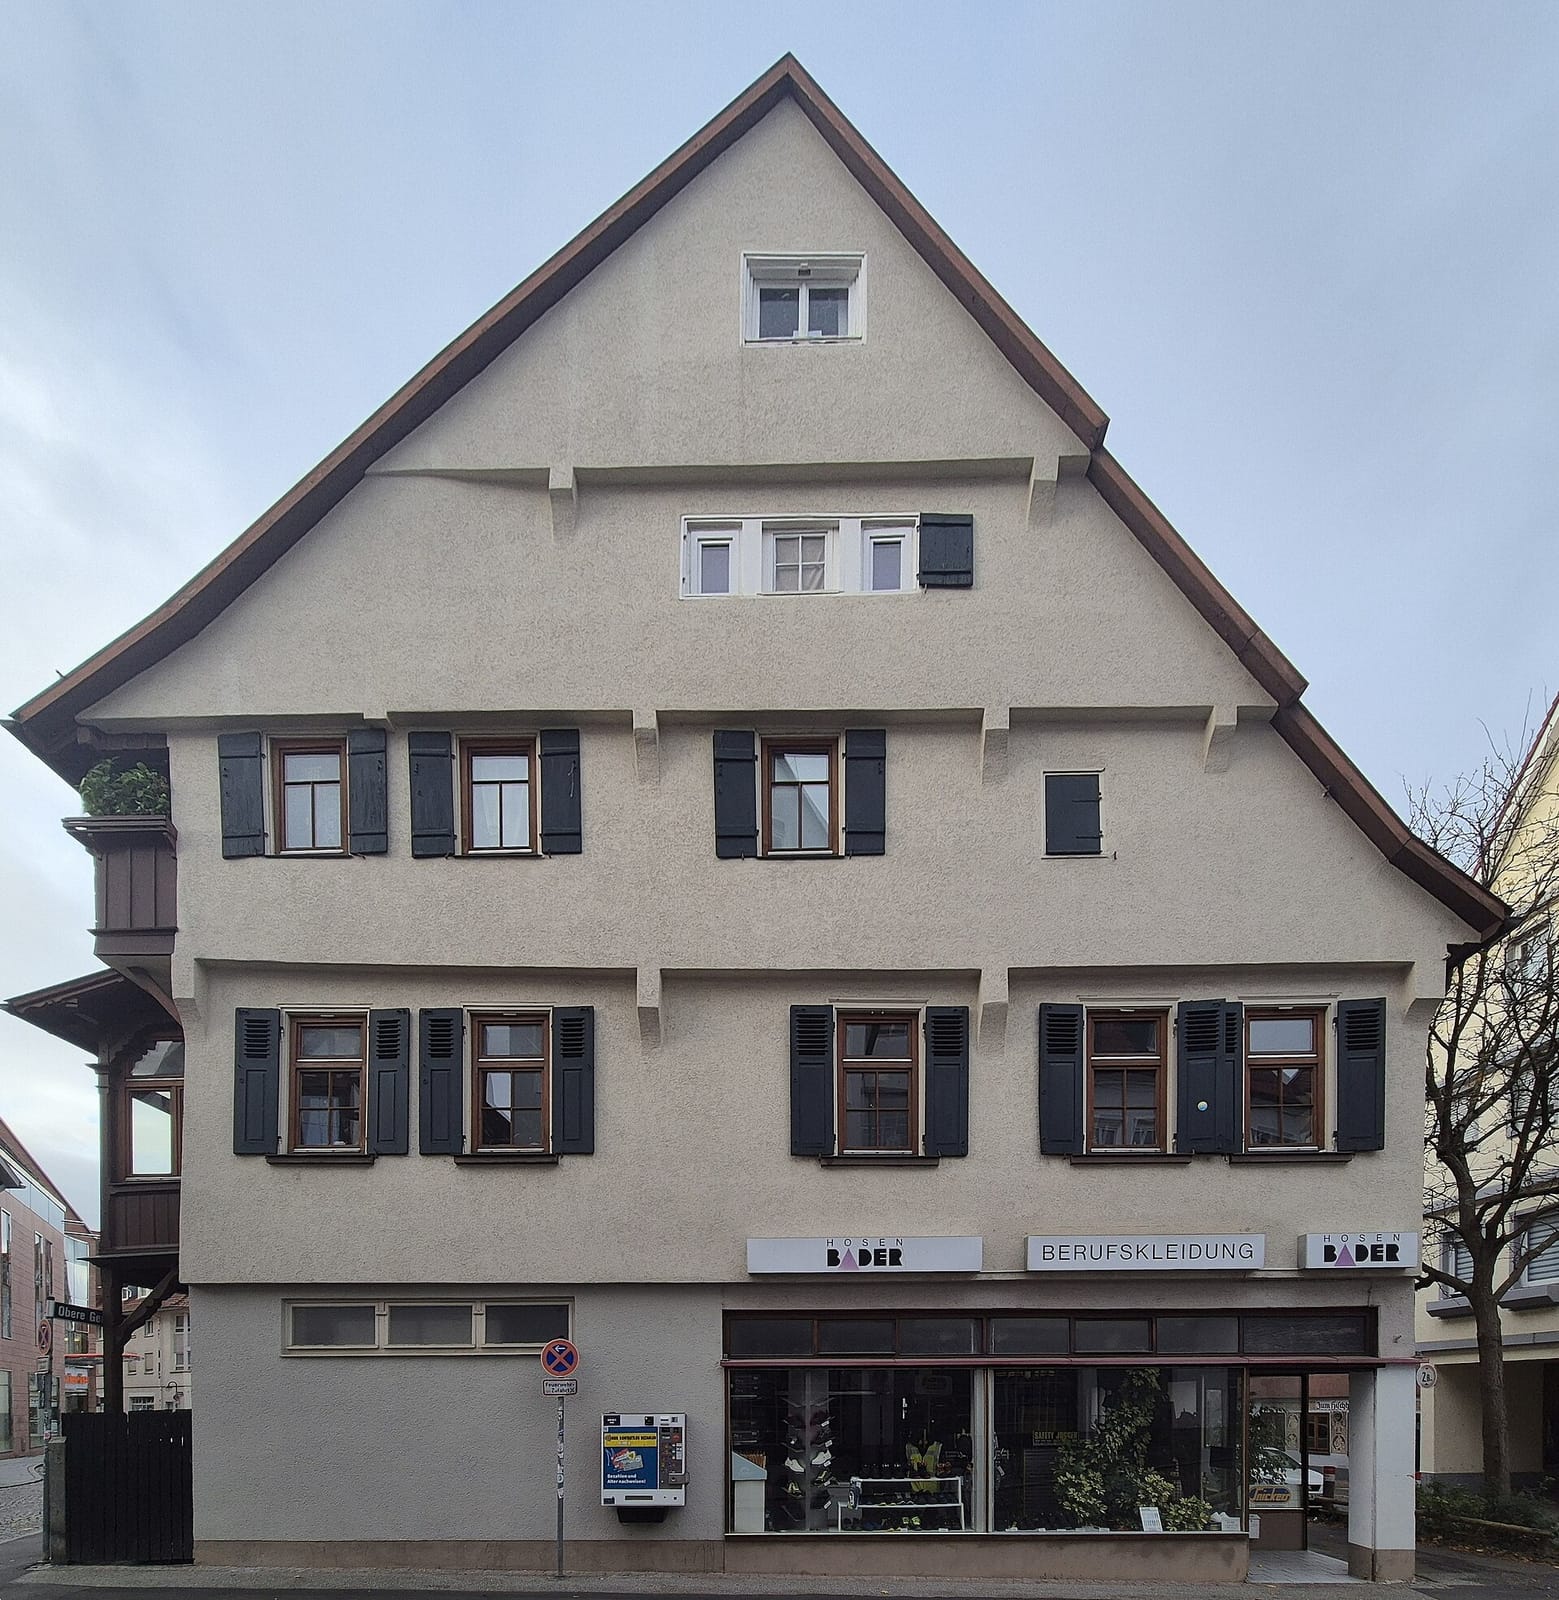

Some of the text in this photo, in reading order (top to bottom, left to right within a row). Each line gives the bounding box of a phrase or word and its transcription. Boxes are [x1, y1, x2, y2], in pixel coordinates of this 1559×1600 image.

[826, 1238, 903, 1247] HOSEN
[1323, 1233, 1400, 1242] HOSEN
[1041, 1243, 1254, 1261] BERUFSKLEIDUNG
[58, 1305, 103, 1323] Obere Ge
